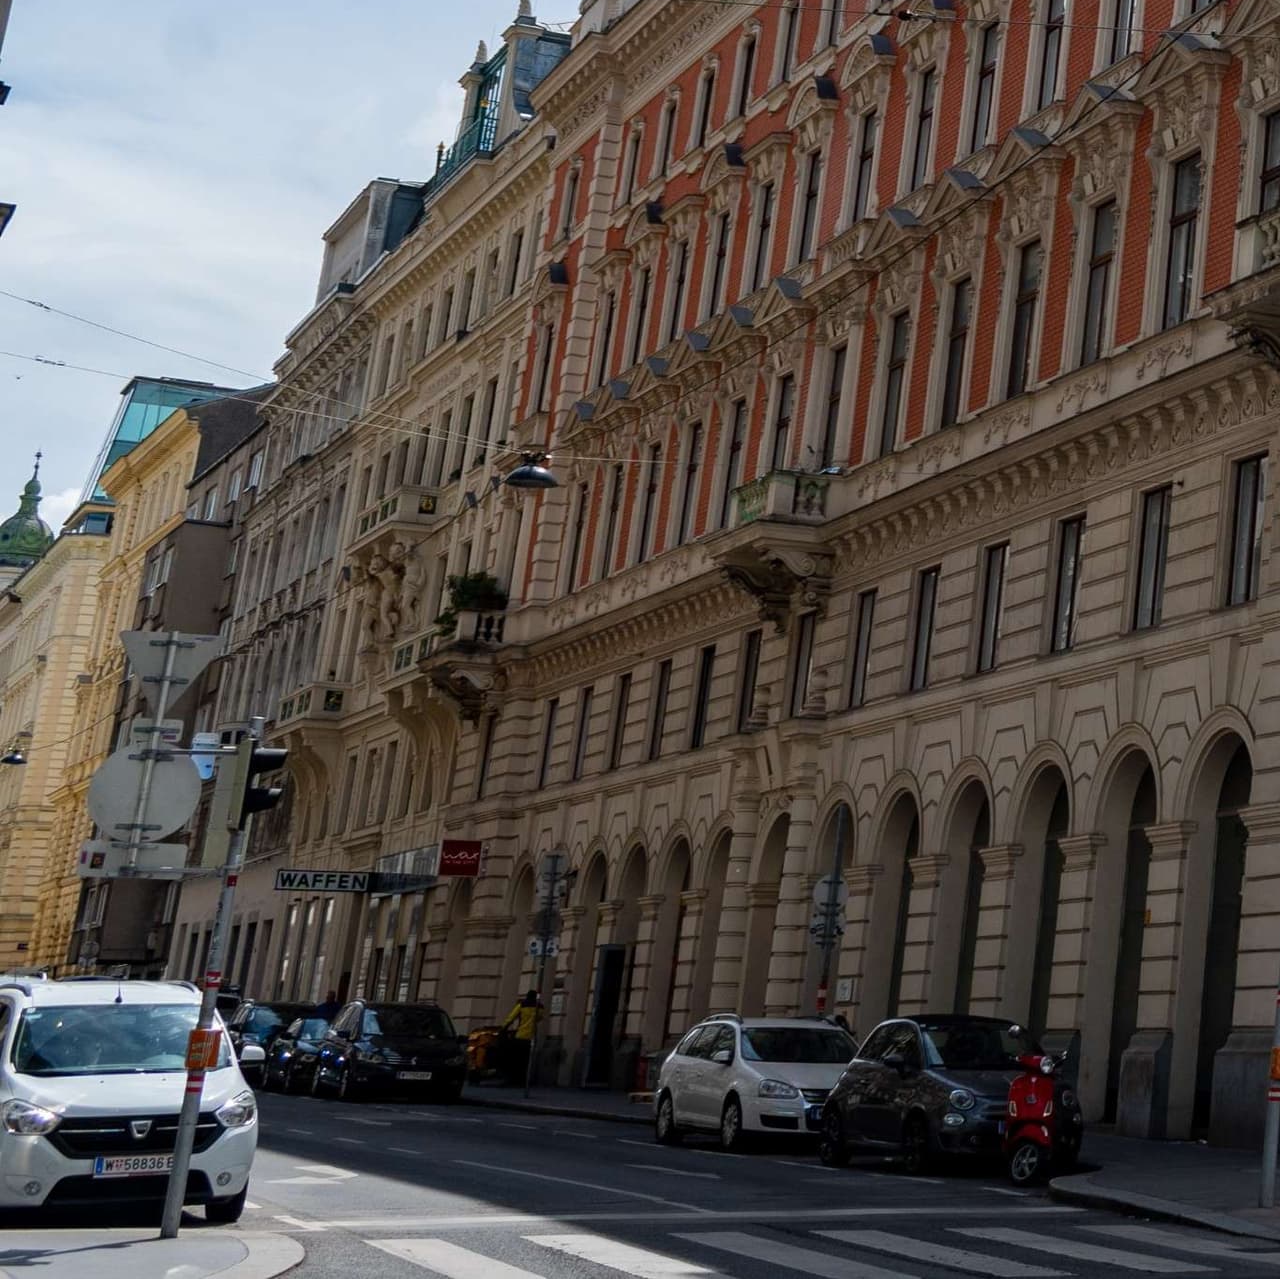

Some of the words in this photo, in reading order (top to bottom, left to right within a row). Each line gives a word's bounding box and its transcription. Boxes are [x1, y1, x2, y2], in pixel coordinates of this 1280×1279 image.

[280, 873, 367, 889] WAFFEN
[105, 1159, 113, 1171] W
[125, 1157, 164, 1170] 58836
